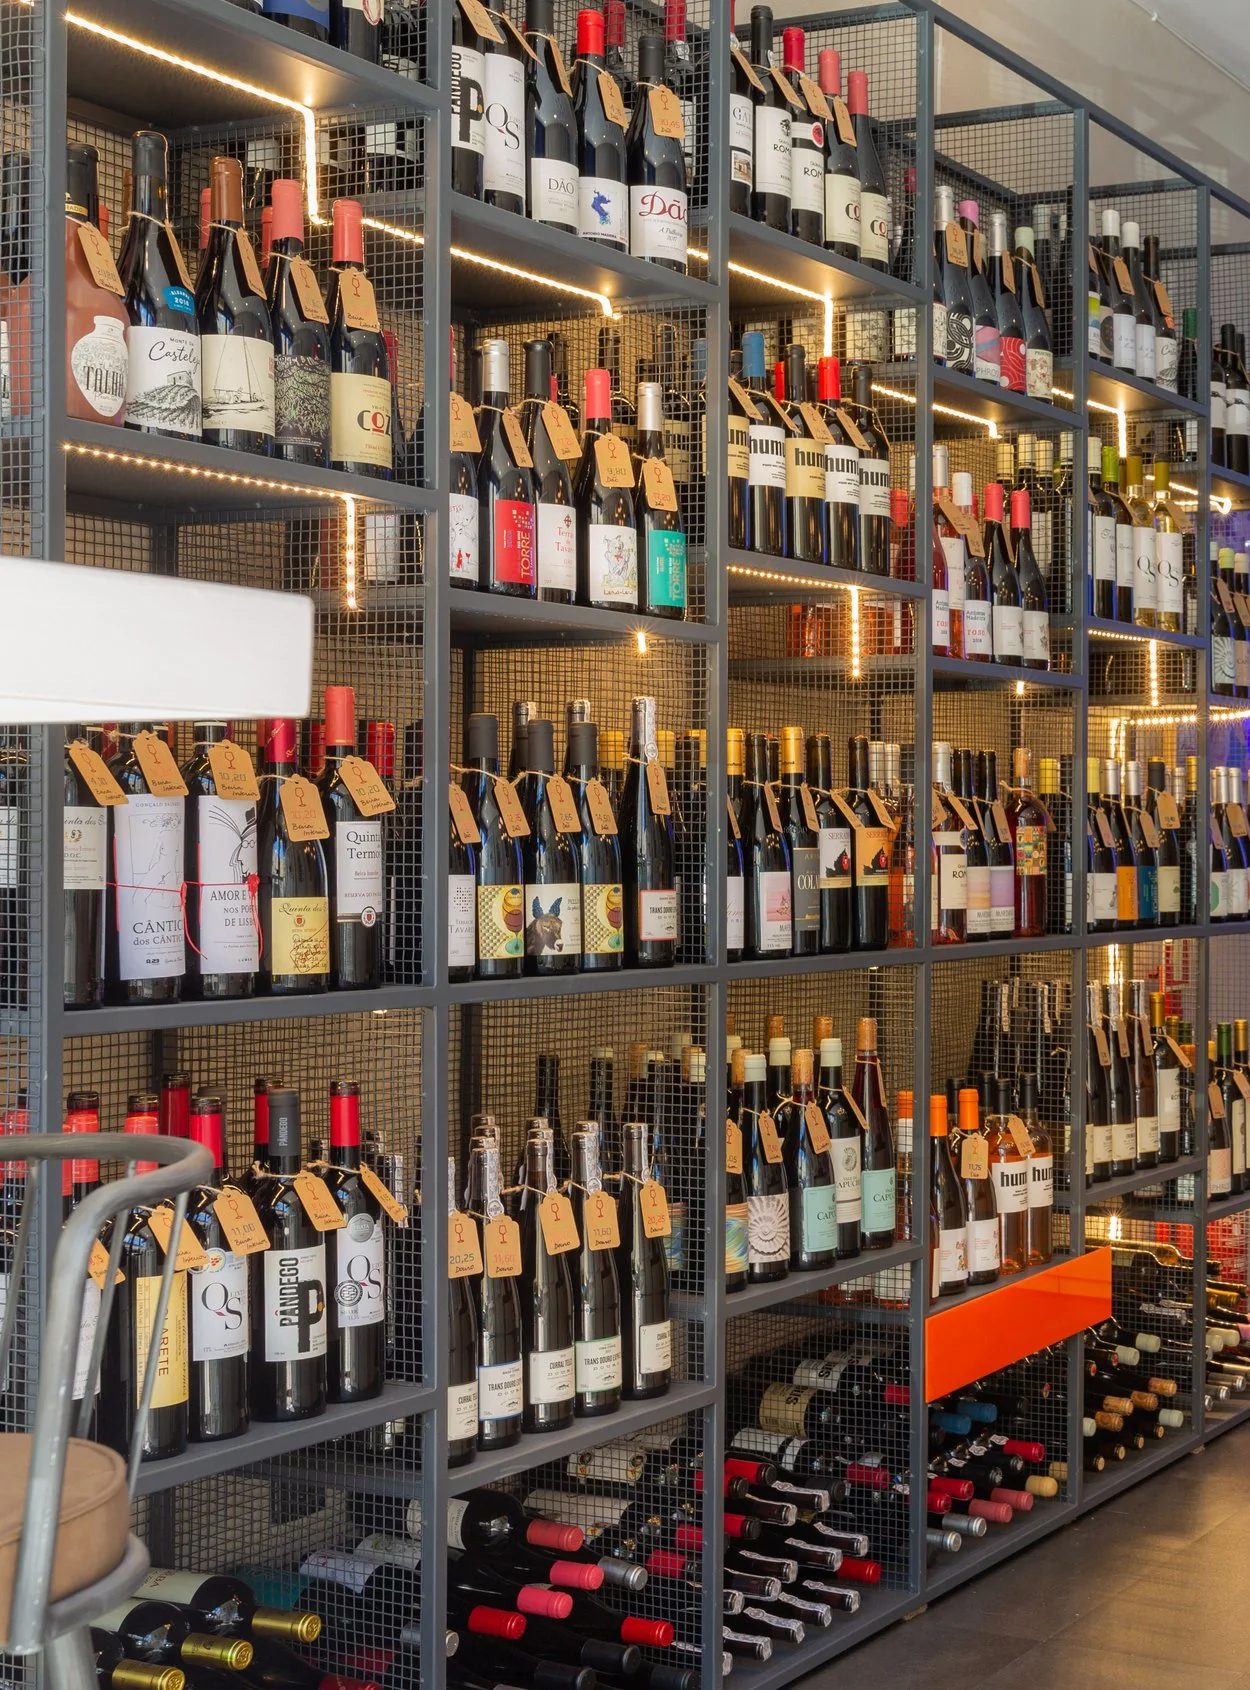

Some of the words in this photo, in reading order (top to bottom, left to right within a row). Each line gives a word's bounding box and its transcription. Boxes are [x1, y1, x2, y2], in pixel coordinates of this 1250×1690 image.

[548, 177, 576, 196] DÃO
[169, 337, 187, 346] MONTE
[357, 410, 392, 437] COZ
[794, 447, 826, 468] hum
[858, 467, 890, 487] hum
[520, 531, 531, 579] TORRE
[936, 619, 949, 627] ros
[219, 771, 247, 782] 10,20
[355, 784, 381, 796] 10,20
[797, 873, 818, 890] COL
[210, 889, 240, 901] AMOR
[223, 906, 240, 914] NOS
[278, 902, 311, 916] Quinta
[132, 919, 183, 935] CÂNTIC
[224, 918, 237, 926] DE
[238, 917, 256, 927] LISB
[133, 936, 150, 946] dos
[1000, 1171, 1028, 1188] hum
[554, 1241, 571, 1250] Douro
[595, 1239, 613, 1247] Douro
[449, 1253, 475, 1265] 20,25
[455, 1265, 475, 1273] Douro
[274, 1256, 300, 1327] PÂNDEGO
[549, 1360, 565, 1370] CURRAL
[584, 1356, 599, 1366] TRANS
[599, 1354, 612, 1364] DOURO
[487, 1382, 503, 1392] TRANS
